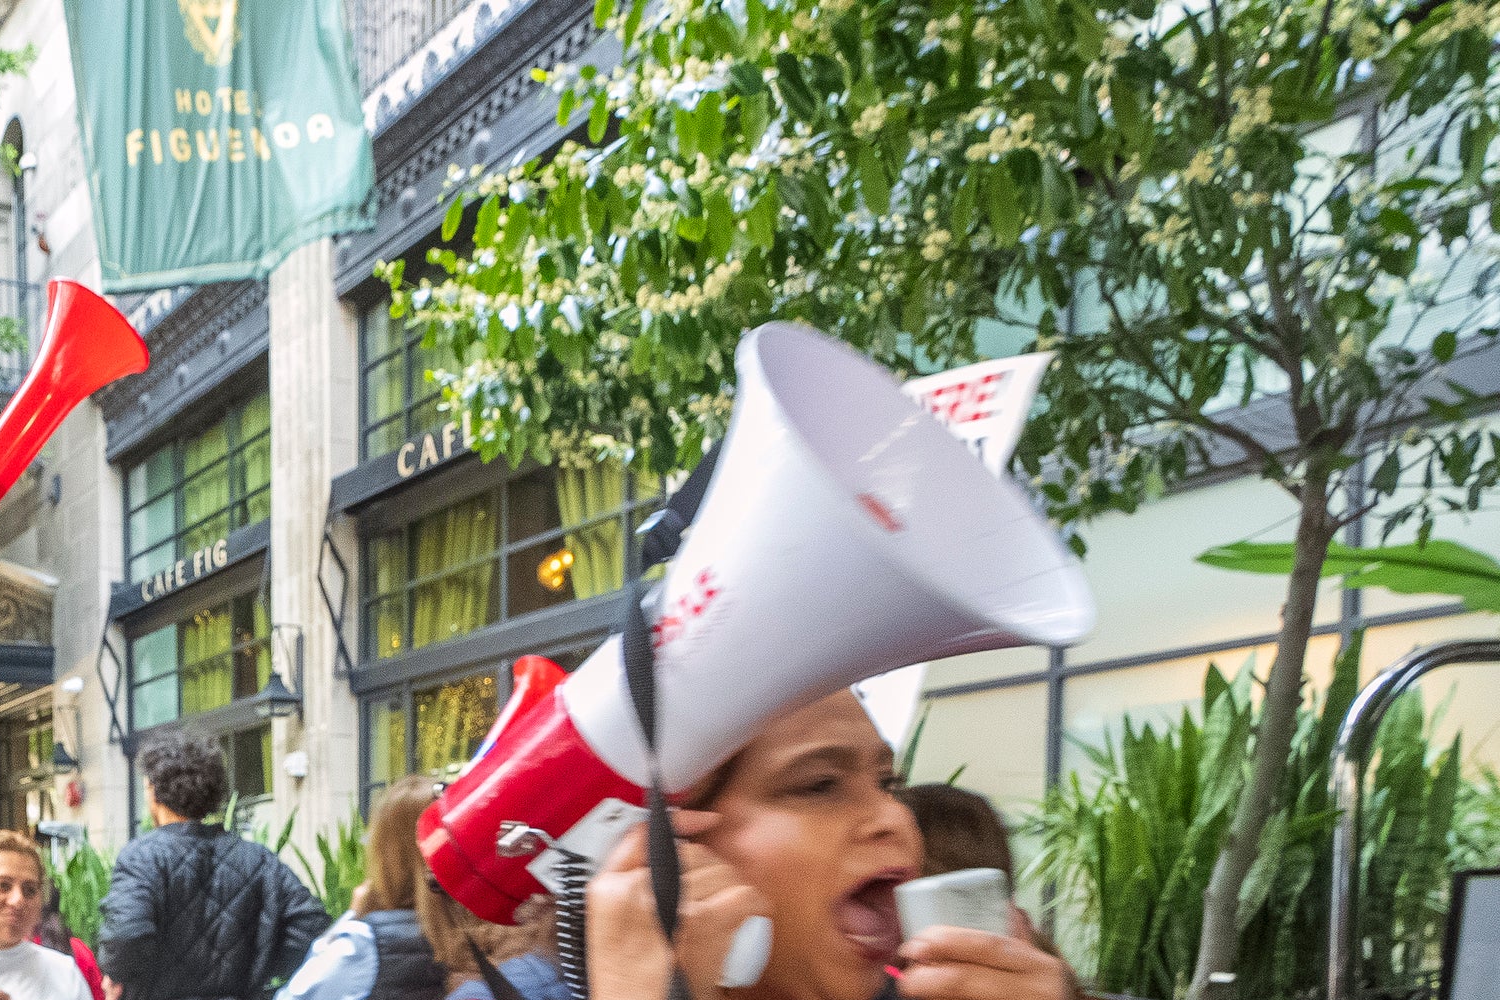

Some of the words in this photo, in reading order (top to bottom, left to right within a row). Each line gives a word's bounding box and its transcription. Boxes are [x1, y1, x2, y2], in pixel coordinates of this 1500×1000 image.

[175, 87, 262, 118] HOTE
[140, 563, 186, 603] CAFE
[193, 538, 228, 580] FIG
